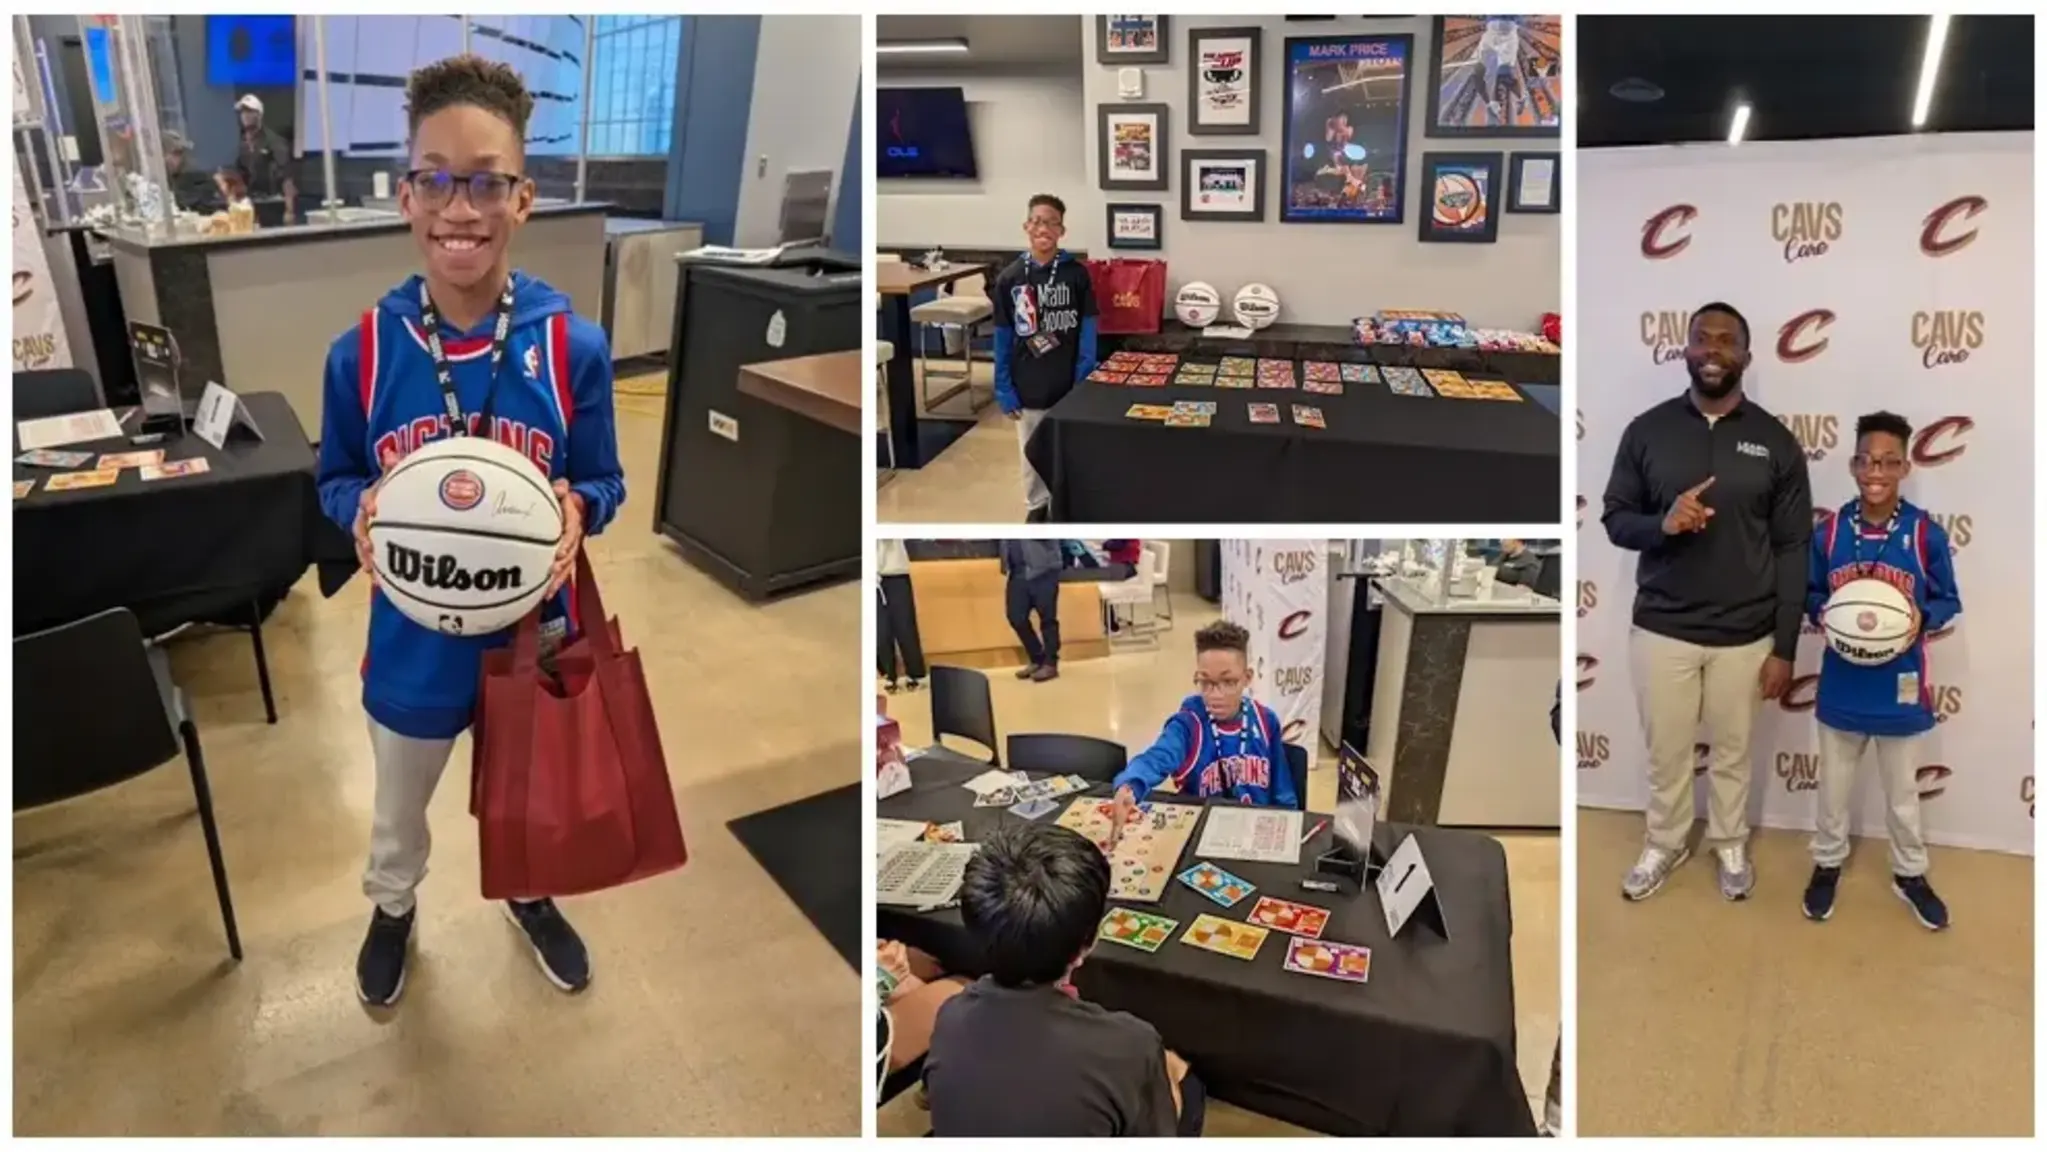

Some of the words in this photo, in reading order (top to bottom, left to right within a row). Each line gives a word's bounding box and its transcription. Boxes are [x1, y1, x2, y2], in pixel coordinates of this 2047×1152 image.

[1309, 45, 1347, 57] MARK
[1349, 43, 1390, 56] PRICE
[1772, 202, 1843, 242] CAVS
[1784, 236, 1829, 264] Care
[1037, 281, 1071, 308] Math
[1640, 311, 1690, 347] CAV
[1911, 310, 1985, 349] CAVS
[1653, 341, 1687, 366] Car
[1922, 343, 1971, 370] Care
[375, 412, 554, 484] PISNS
[386, 540, 522, 591] Wilson
[1274, 551, 1316, 574] CAVS
[1833, 637, 1896, 661] Wilson
[1274, 666, 1313, 688] CAVS
[1777, 751, 1819, 781] CAV
